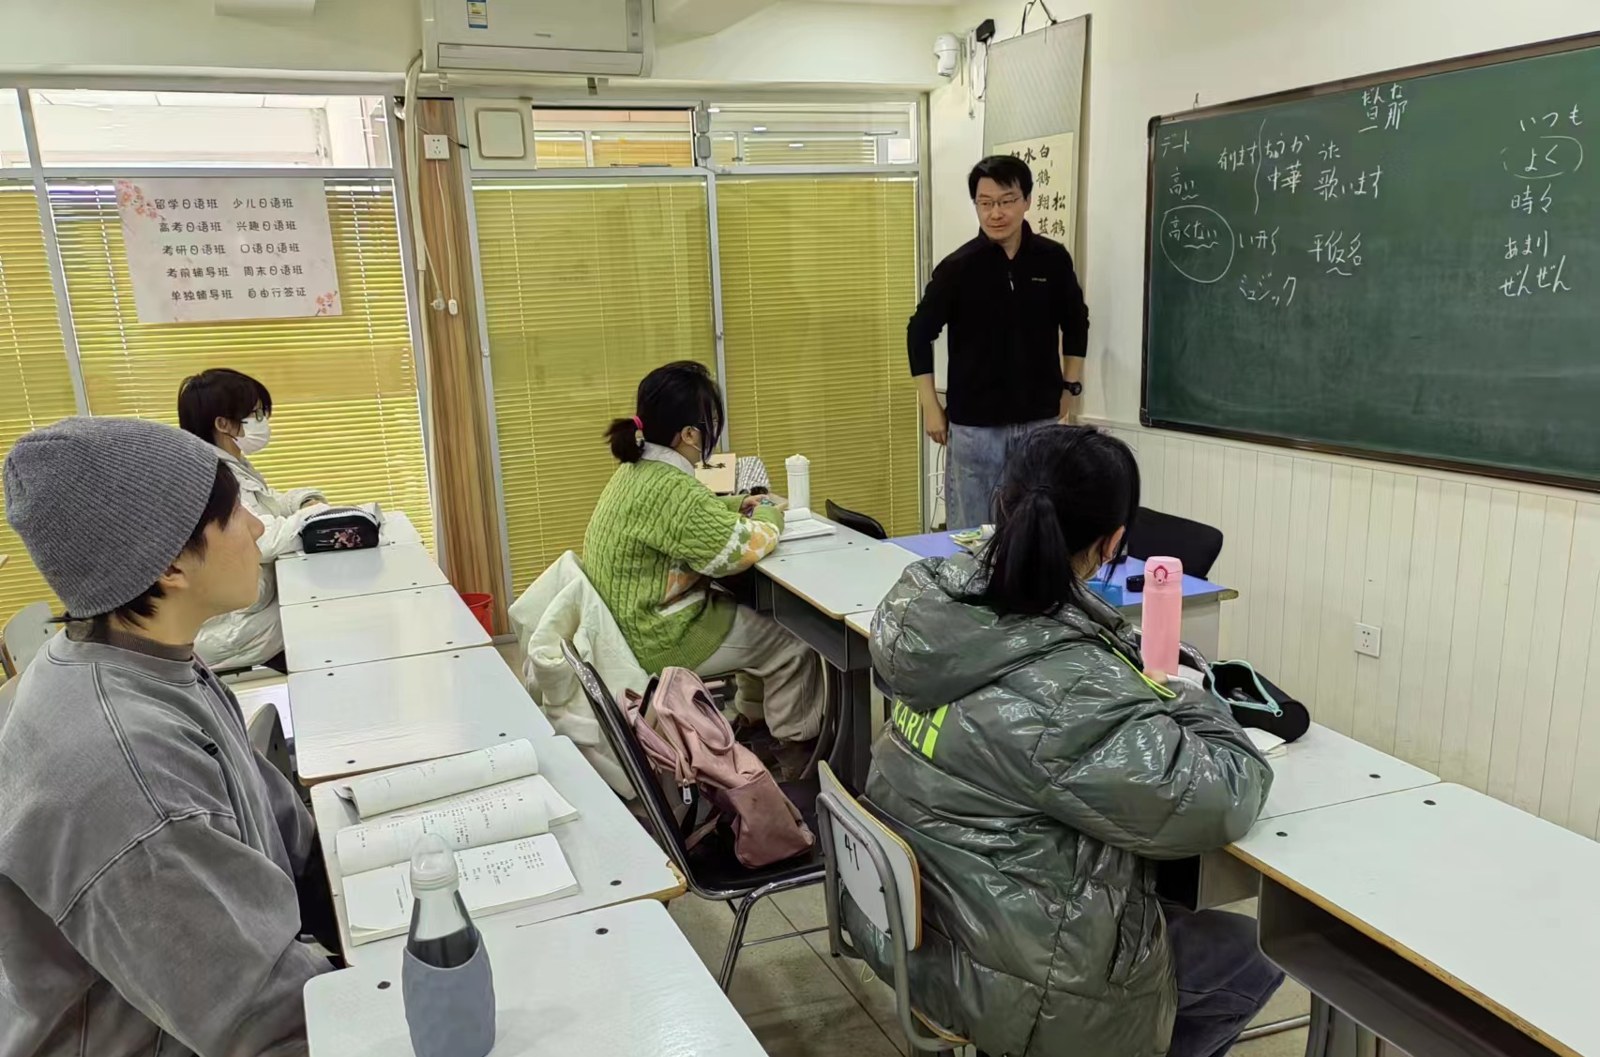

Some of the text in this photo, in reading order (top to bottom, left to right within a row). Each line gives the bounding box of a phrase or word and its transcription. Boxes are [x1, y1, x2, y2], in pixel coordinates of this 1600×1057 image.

[1520, 104, 1583, 131] いつも
[1525, 144, 1558, 172] よく
[1169, 166, 1196, 196] 高い
[1313, 164, 1384, 201] 歌います
[154, 197, 294, 210] 留学日语班 少儿日语班
[1511, 183, 1552, 215] 時々
[159, 220, 297, 233] 高考日语班 兴趣日语班
[1168, 216, 1218, 241] 高くない
[162, 243, 301, 256] 考研日语班 口语日语班
[1307, 230, 1362, 266] 平仮名
[1504, 230, 1549, 260] あまり
[166, 265, 304, 279] 考前辅导班 周末日语班
[1499, 255, 1572, 297] ぜんぜん
[171, 287, 307, 301] 单独辅导班 自由行签证
[893, 699, 925, 749] KARL
[844, 833, 860, 871] 41
